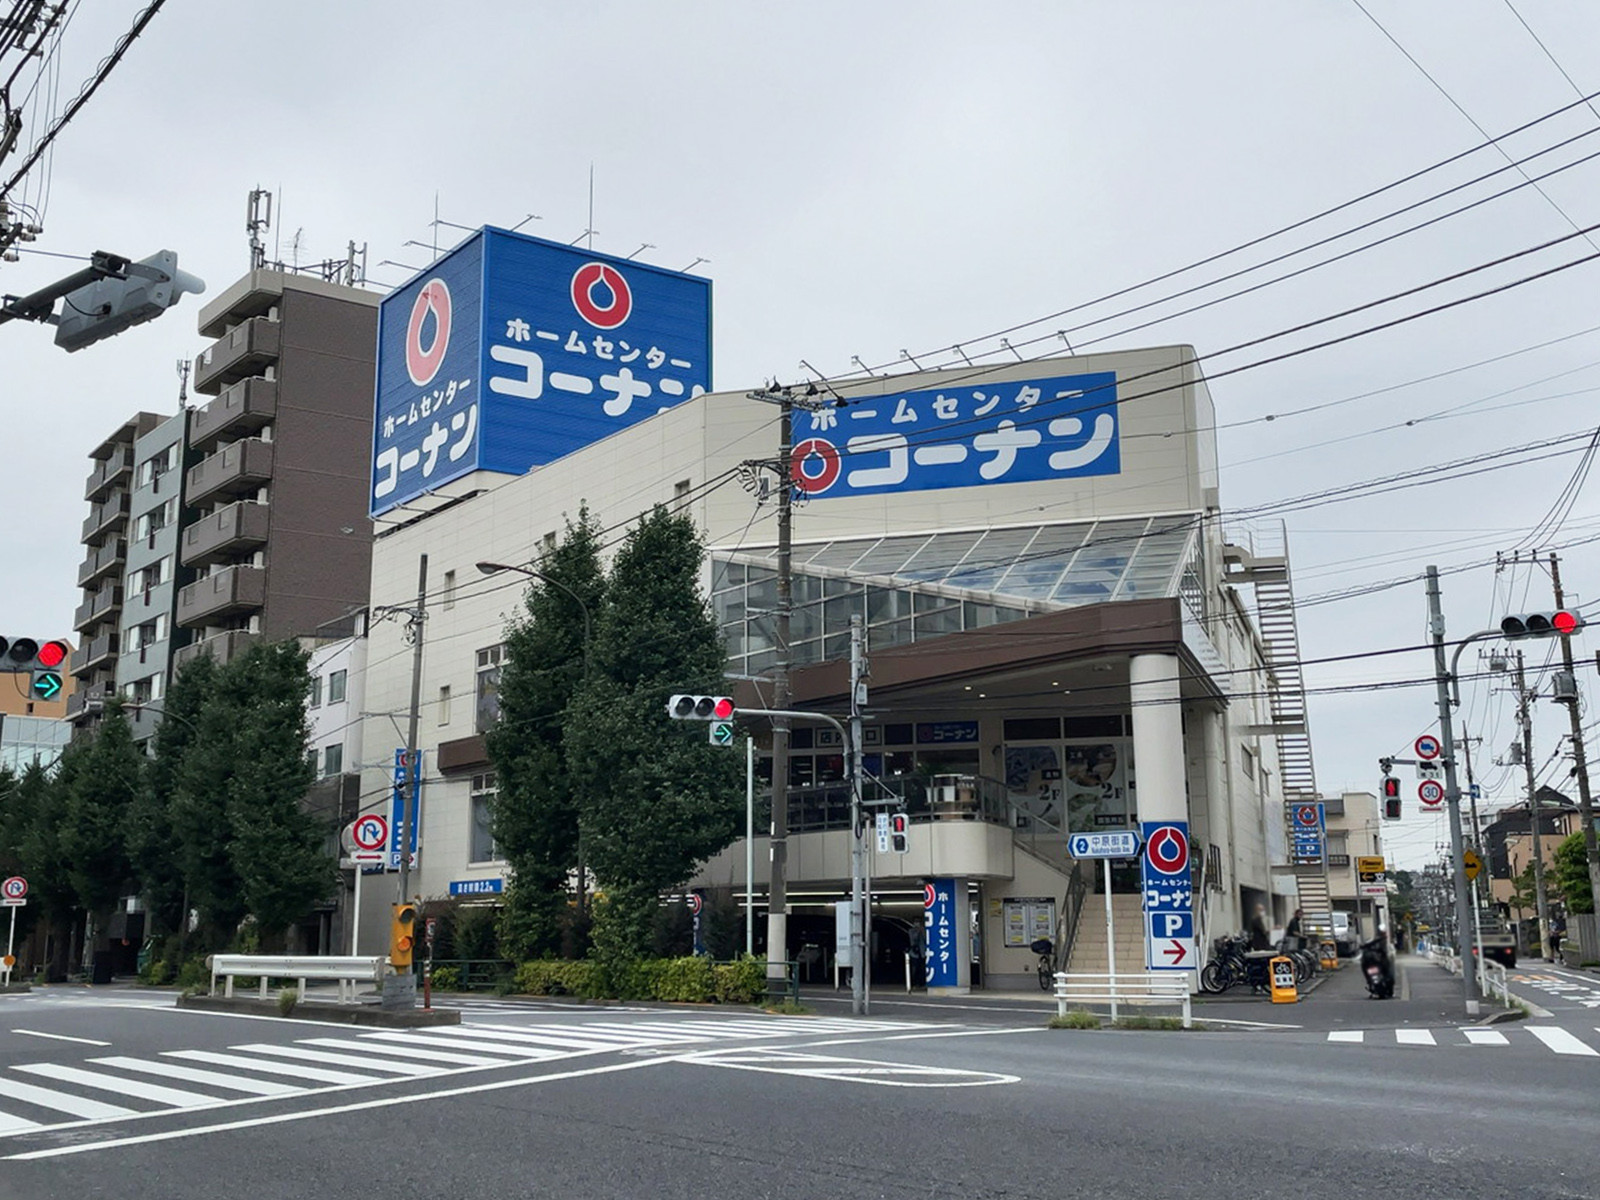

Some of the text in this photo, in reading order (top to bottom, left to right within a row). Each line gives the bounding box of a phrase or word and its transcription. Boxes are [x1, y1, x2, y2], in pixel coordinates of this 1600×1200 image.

[506, 318, 691, 369] ホームセンター
[383, 379, 470, 438] ホームセンター
[810, 385, 1084, 432] ホームセンター
[375, 404, 477, 499] コーナン
[847, 413, 1114, 488] コーナン
[934, 728, 977, 740] コーナン
[1040, 784, 1060, 801] 2F
[1102, 782, 1123, 799] 2F
[1424, 786, 1439, 798] 30
[1079, 841, 1086, 851] 2
[1091, 835, 1129, 847] 中原街道
[1147, 889, 1192, 908] コーナン
[938, 891, 950, 974] ホームセンター
[1165, 914, 1183, 936] P
